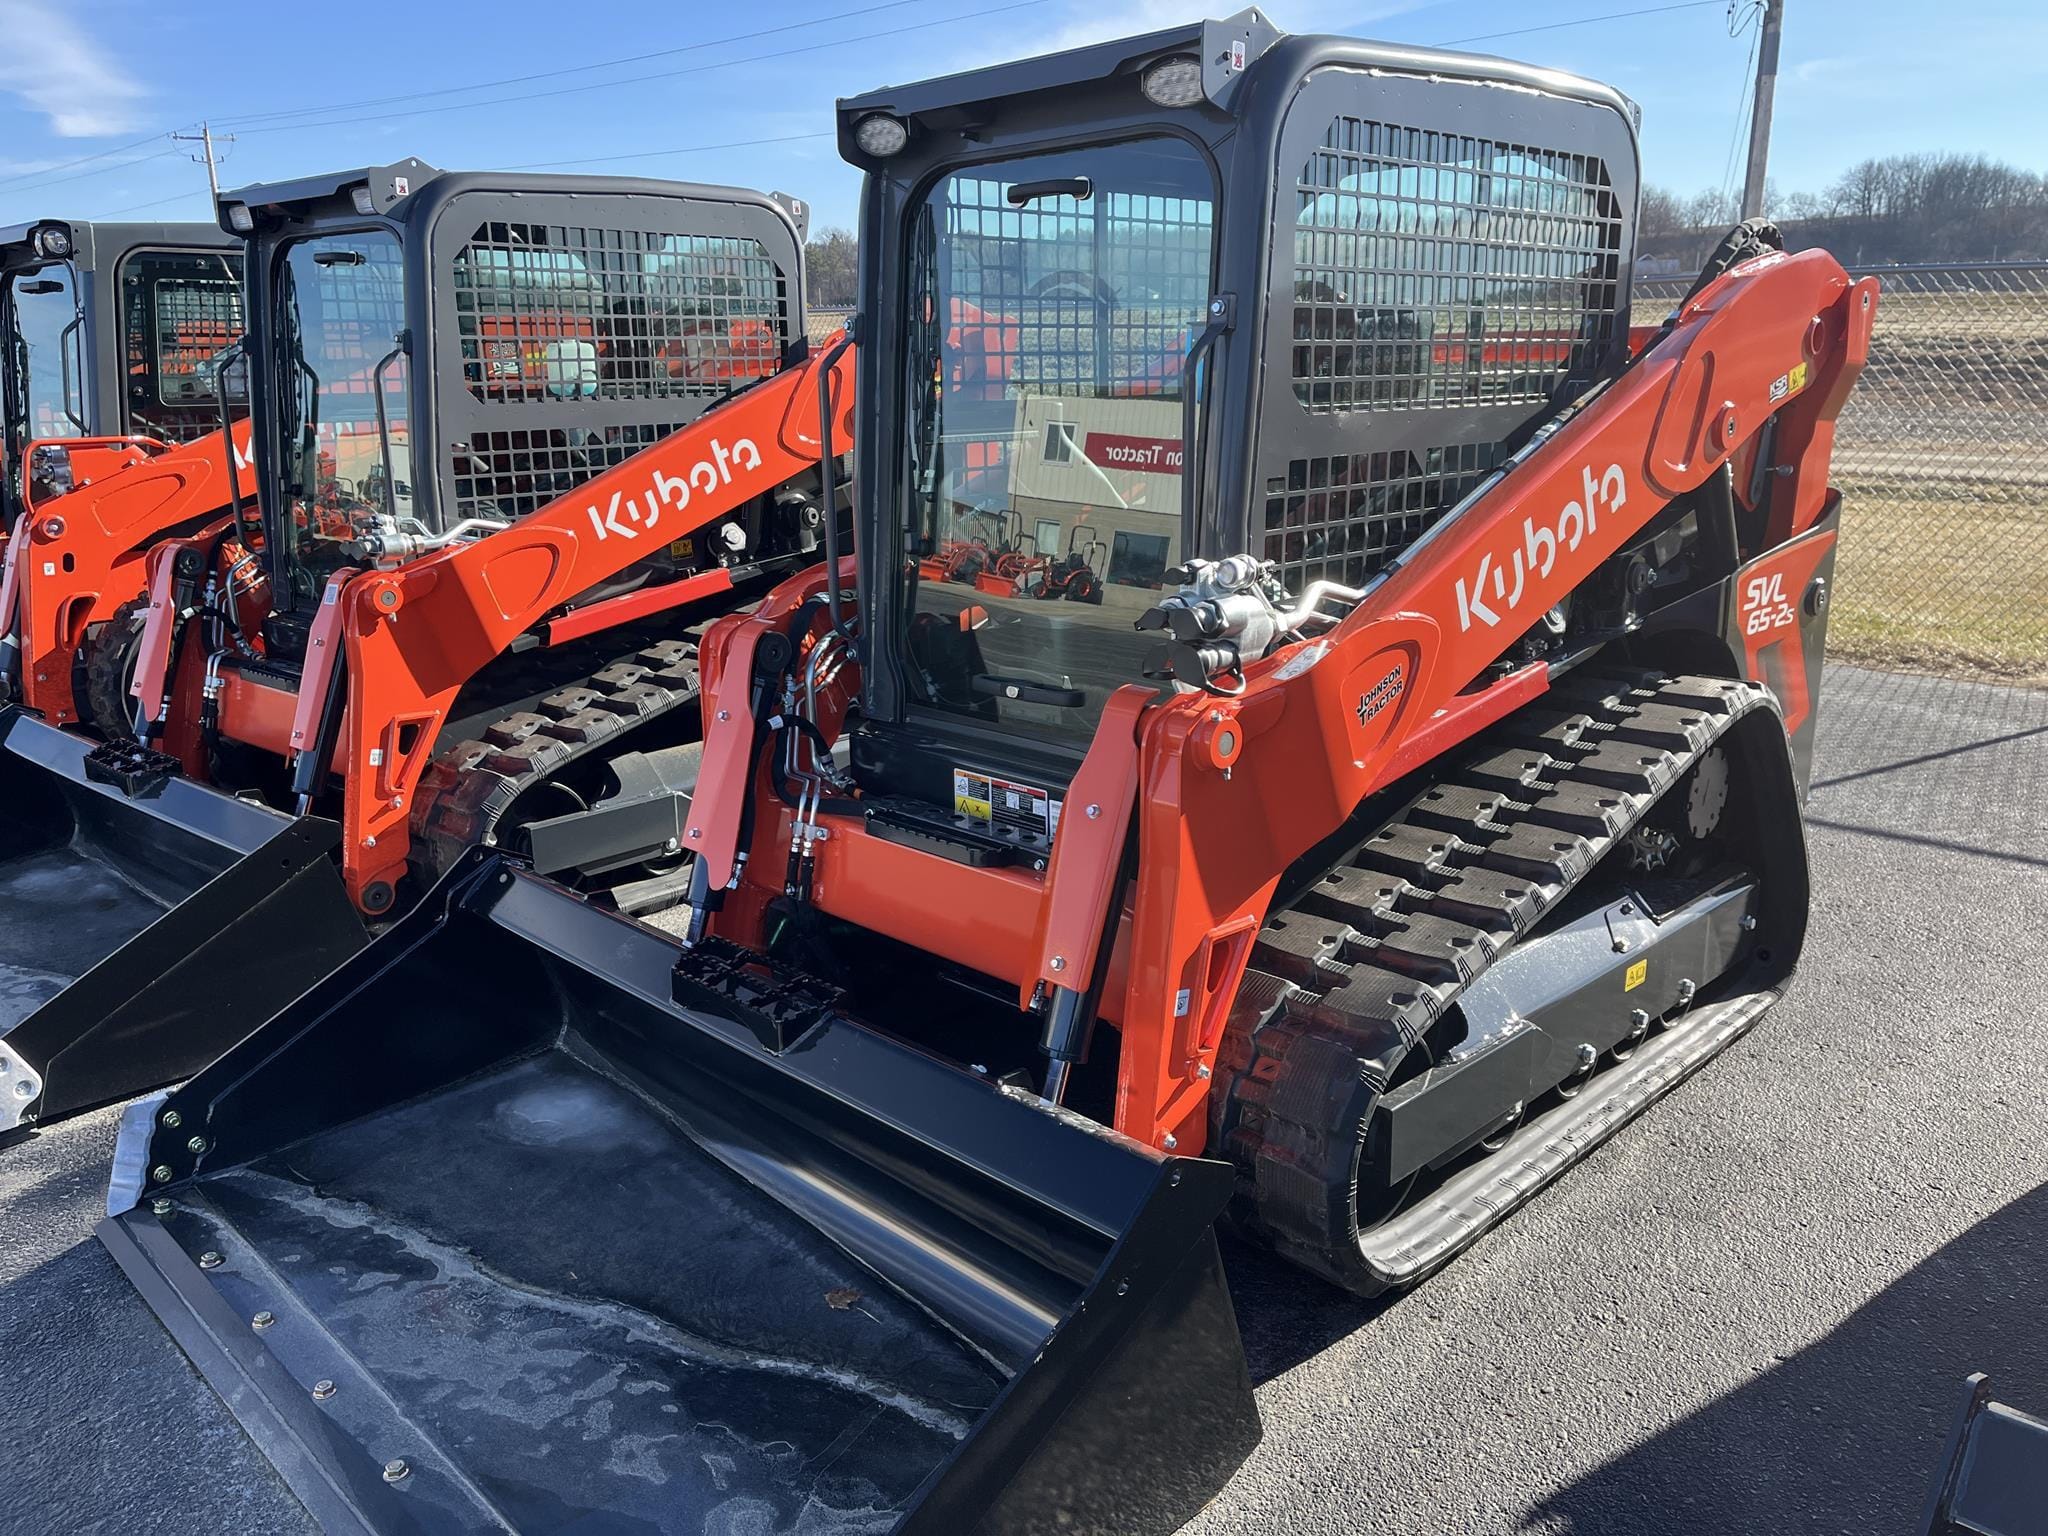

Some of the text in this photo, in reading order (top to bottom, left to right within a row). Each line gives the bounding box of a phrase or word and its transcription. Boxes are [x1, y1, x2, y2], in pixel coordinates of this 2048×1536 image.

[587, 438, 762, 541] Kubota
[1455, 463, 1627, 633] Kubota
[1743, 573, 1787, 611] SVL
[1356, 664, 1402, 714] JOHNSON
[1359, 679, 1403, 727] TRACTOR
